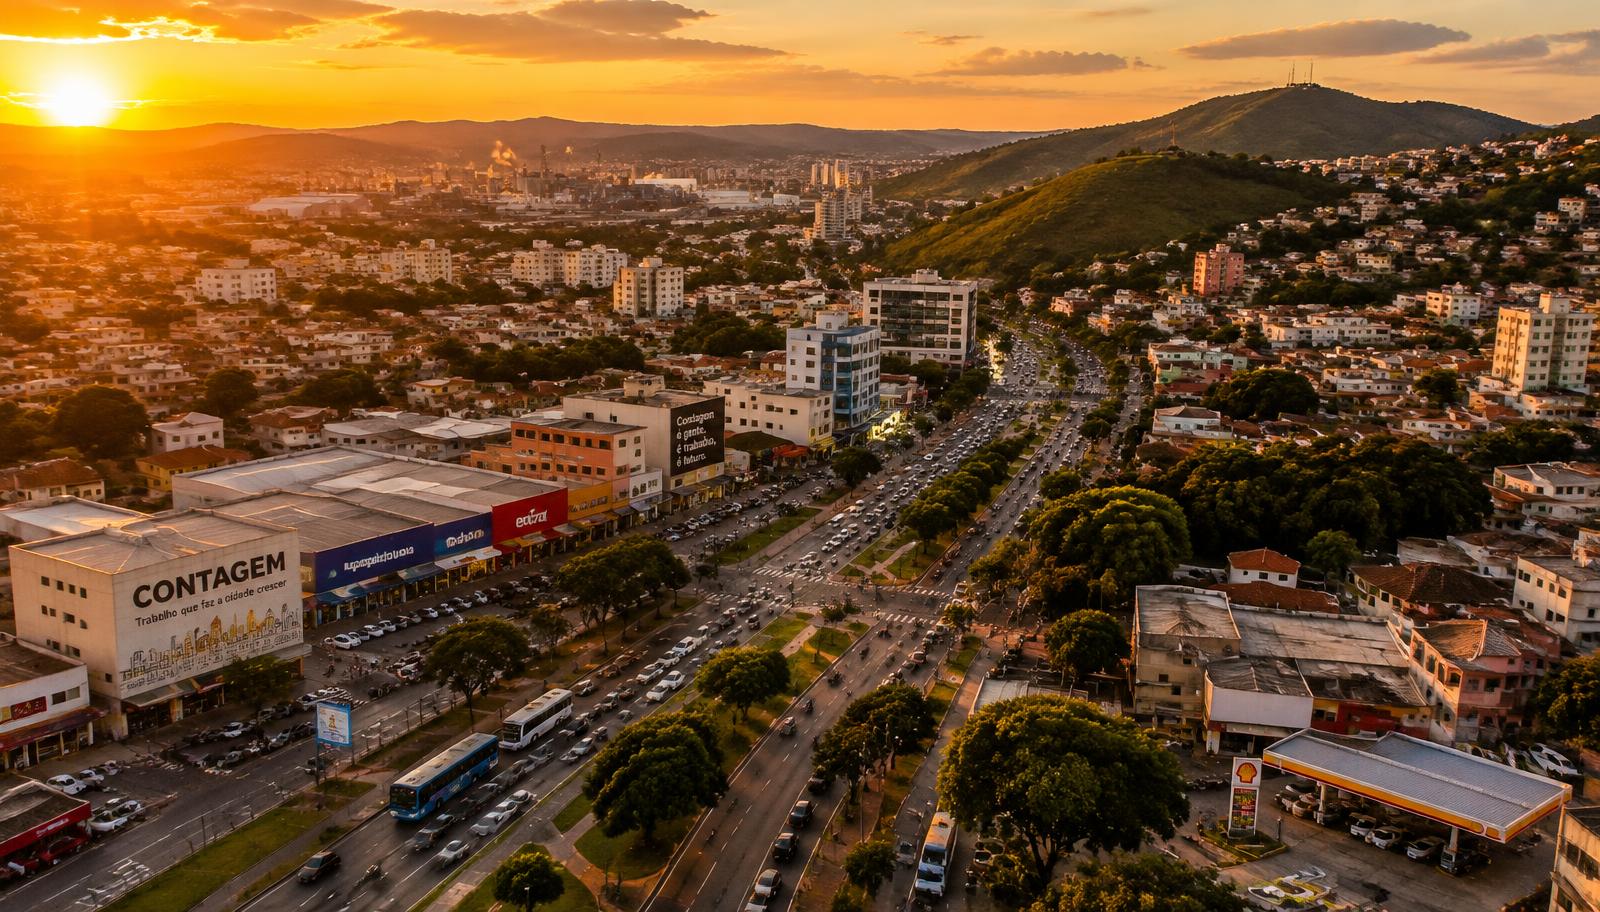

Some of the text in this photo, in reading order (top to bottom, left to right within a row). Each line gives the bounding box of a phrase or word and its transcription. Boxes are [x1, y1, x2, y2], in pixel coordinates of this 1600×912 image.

[133, 551, 286, 608] CONTAGEM
[181, 604, 199, 616] que
[257, 579, 287, 594] crescer
